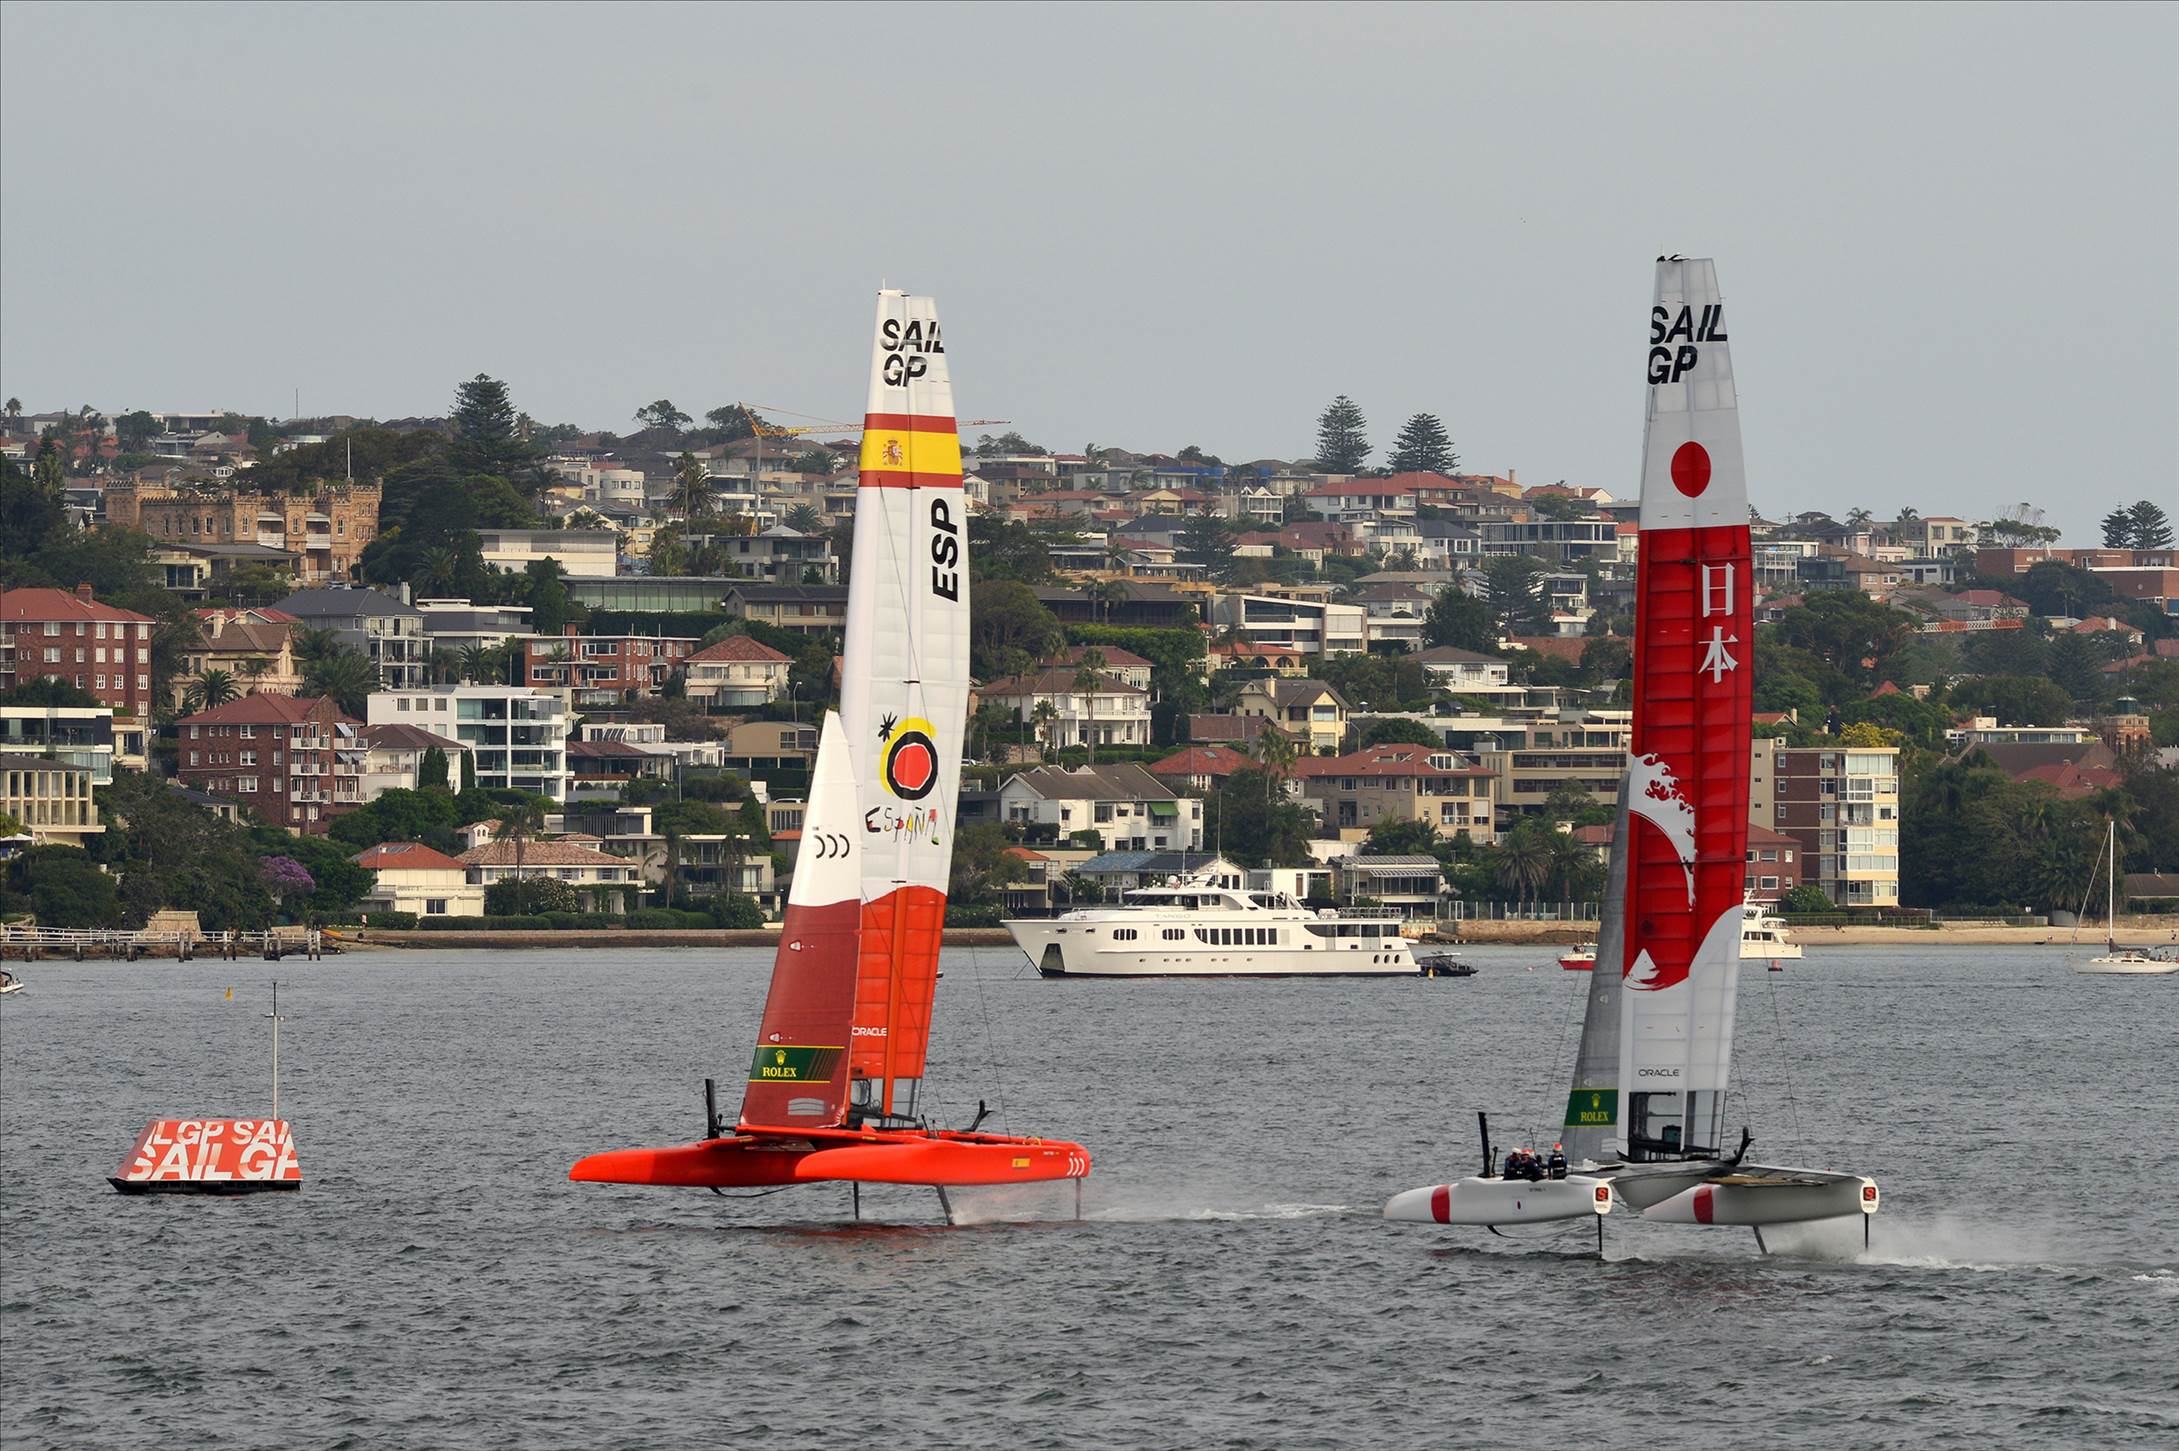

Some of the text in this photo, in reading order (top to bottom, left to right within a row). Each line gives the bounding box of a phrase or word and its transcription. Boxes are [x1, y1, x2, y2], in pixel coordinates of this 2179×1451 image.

[880, 318, 945, 354] SAIL
[1649, 304, 1728, 345] SAIL
[882, 353, 928, 387] GP
[1647, 345, 1698, 385] GP
[931, 497, 959, 603] ESP
[1698, 562, 1739, 684] 日本
[851, 1027, 888, 1037] ORACLE
[762, 1067, 798, 1078] ROLEX
[1638, 1069, 1681, 1077] ORACLE
[176, 1120, 225, 1145] GP
[1580, 1111, 1610, 1122] ROLEX
[127, 1143, 233, 1180] SAIL
